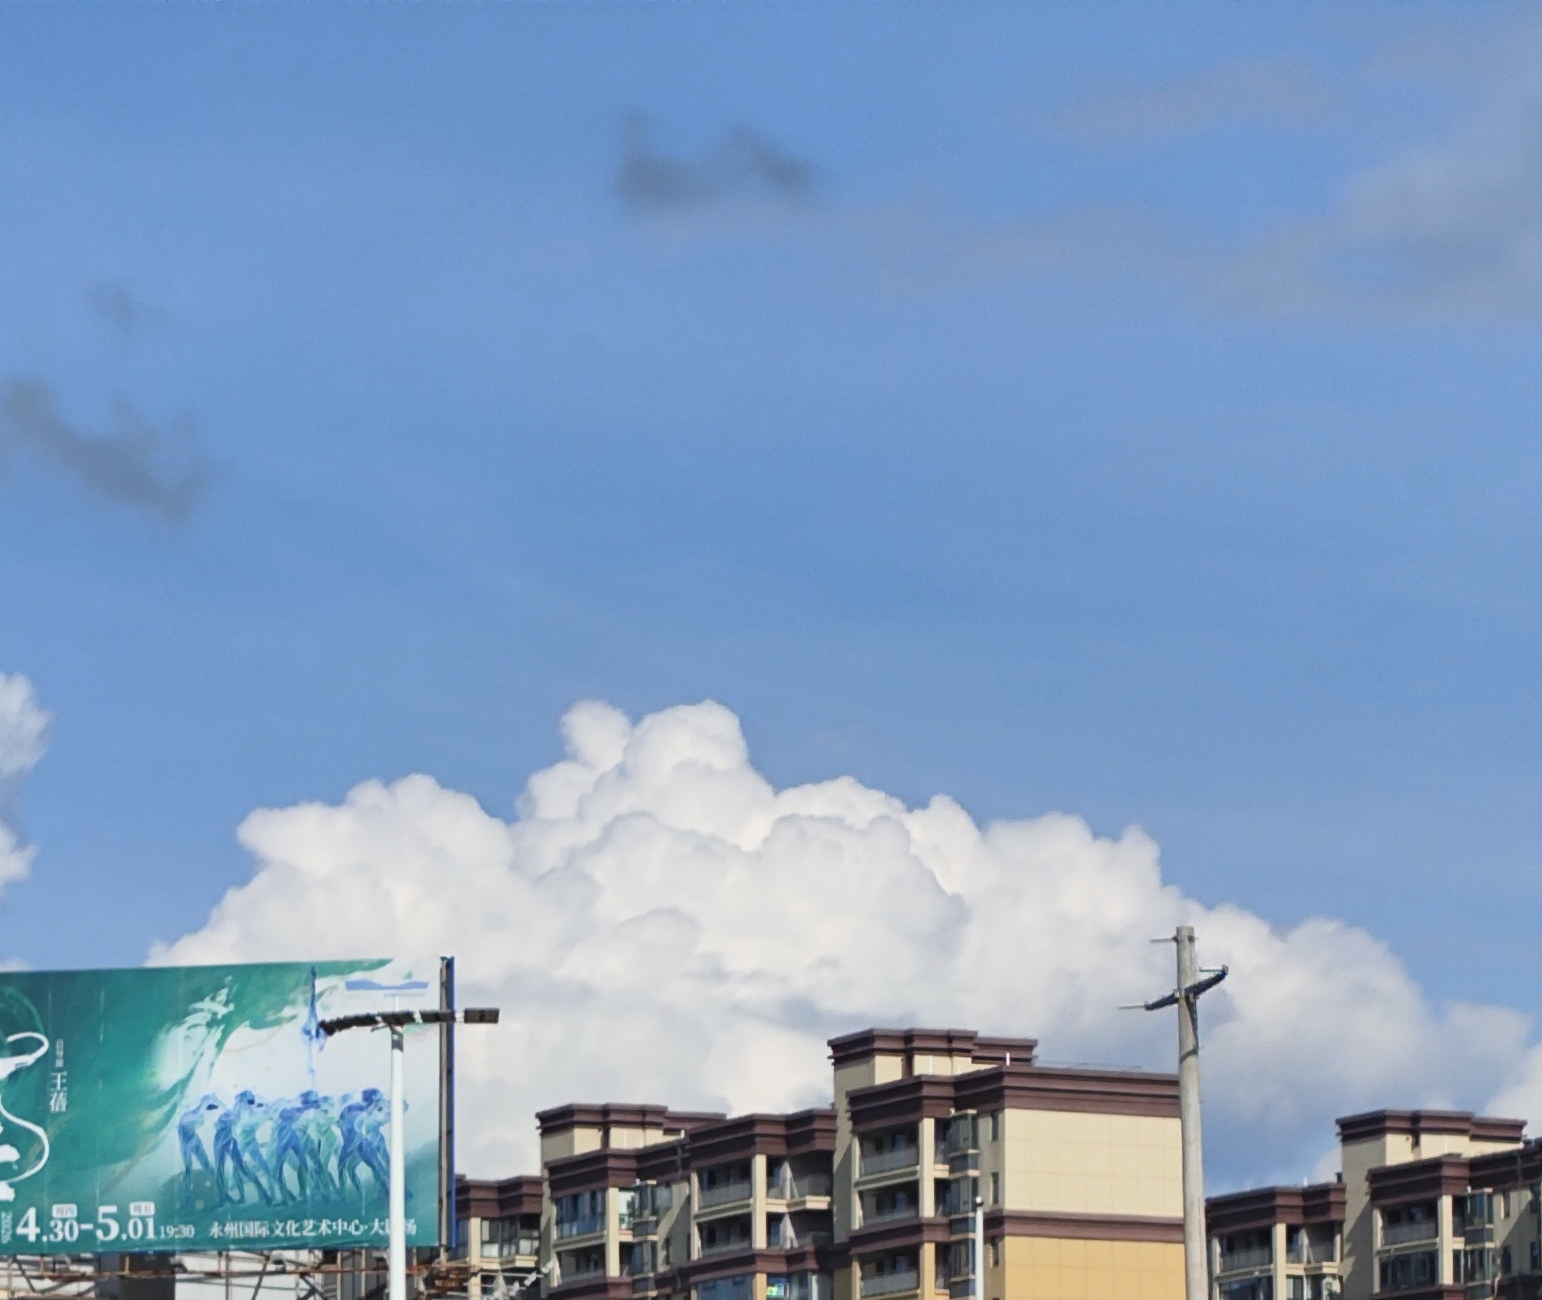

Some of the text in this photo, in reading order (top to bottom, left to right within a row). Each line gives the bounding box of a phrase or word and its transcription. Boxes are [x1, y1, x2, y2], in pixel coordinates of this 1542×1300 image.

[159, 1224, 196, 1239] 19:30
[209, 1217, 418, 1239] 永州国际文化艺术中心·大场
